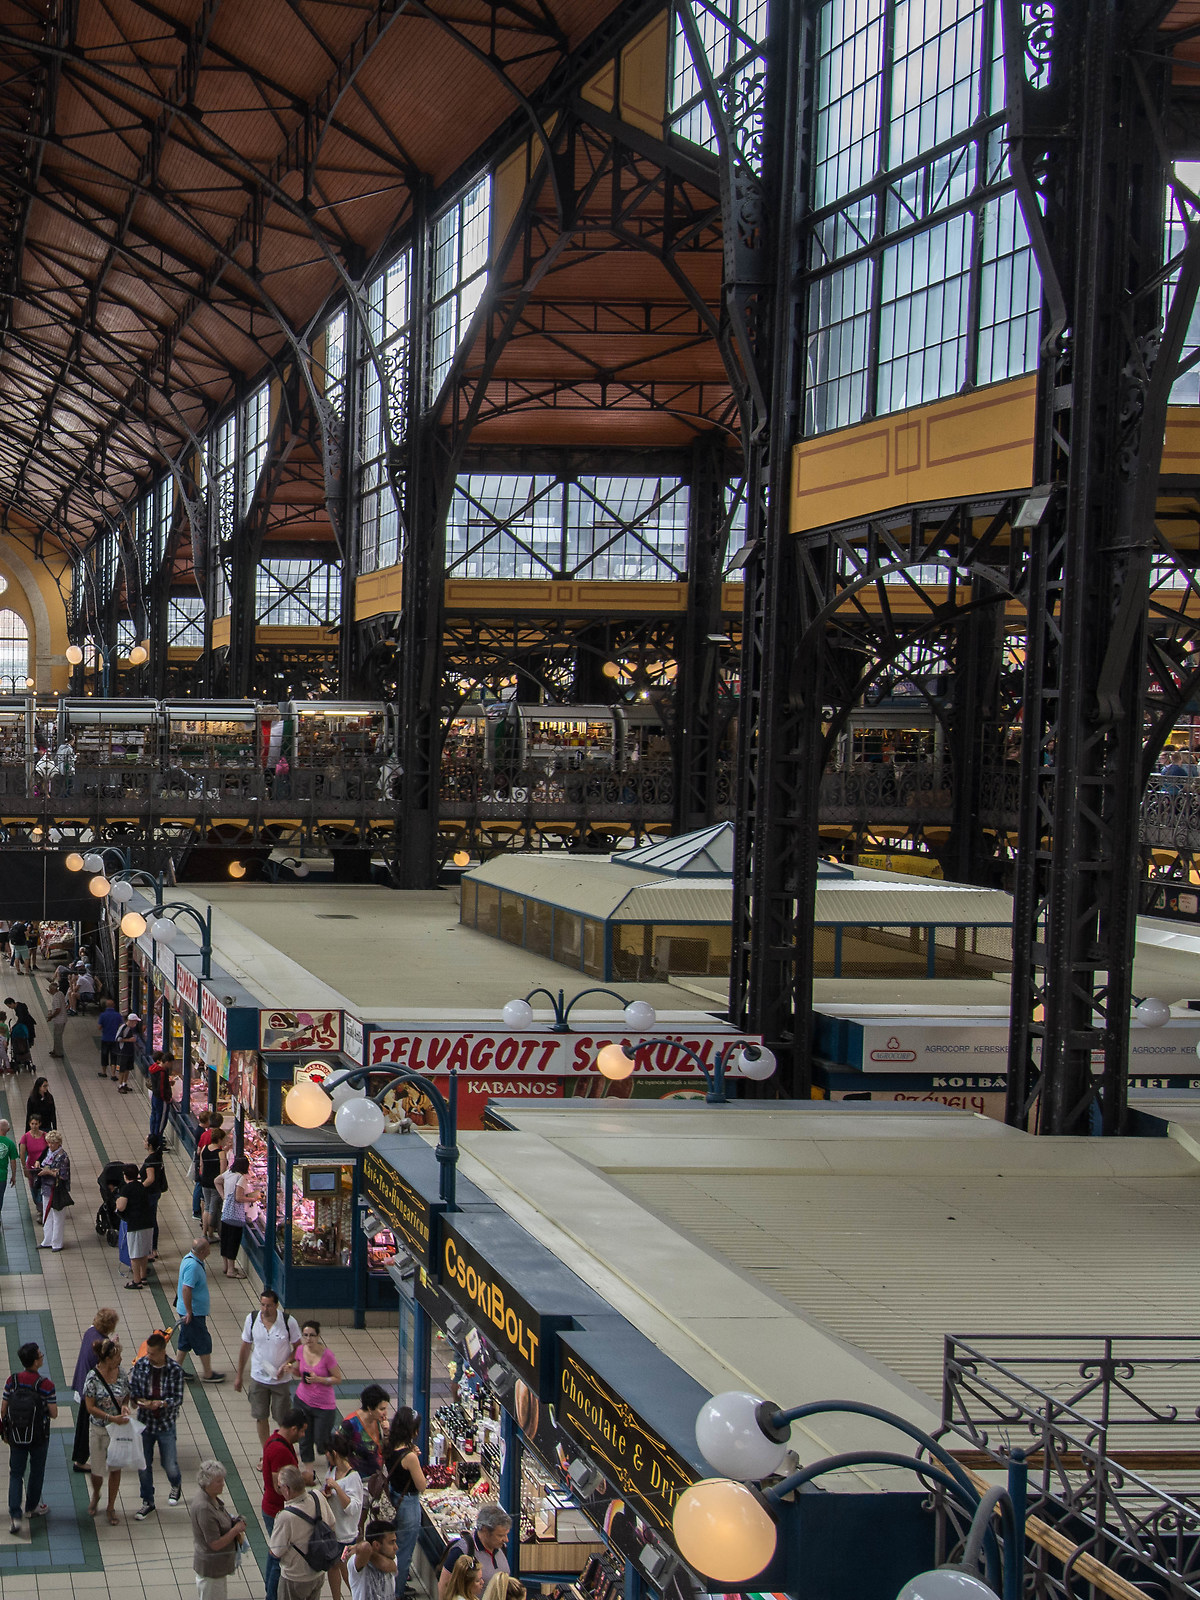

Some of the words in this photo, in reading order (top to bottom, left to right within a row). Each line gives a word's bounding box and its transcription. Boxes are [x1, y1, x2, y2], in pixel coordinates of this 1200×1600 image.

[372, 1034, 560, 1071] FELVÁGOTT
[467, 1080, 557, 1095] KABANOS
[932, 1075, 1007, 1088] KOLBÁ
[562, 1369, 626, 1455] Chocolate
[650, 1459, 680, 1507] Dri
